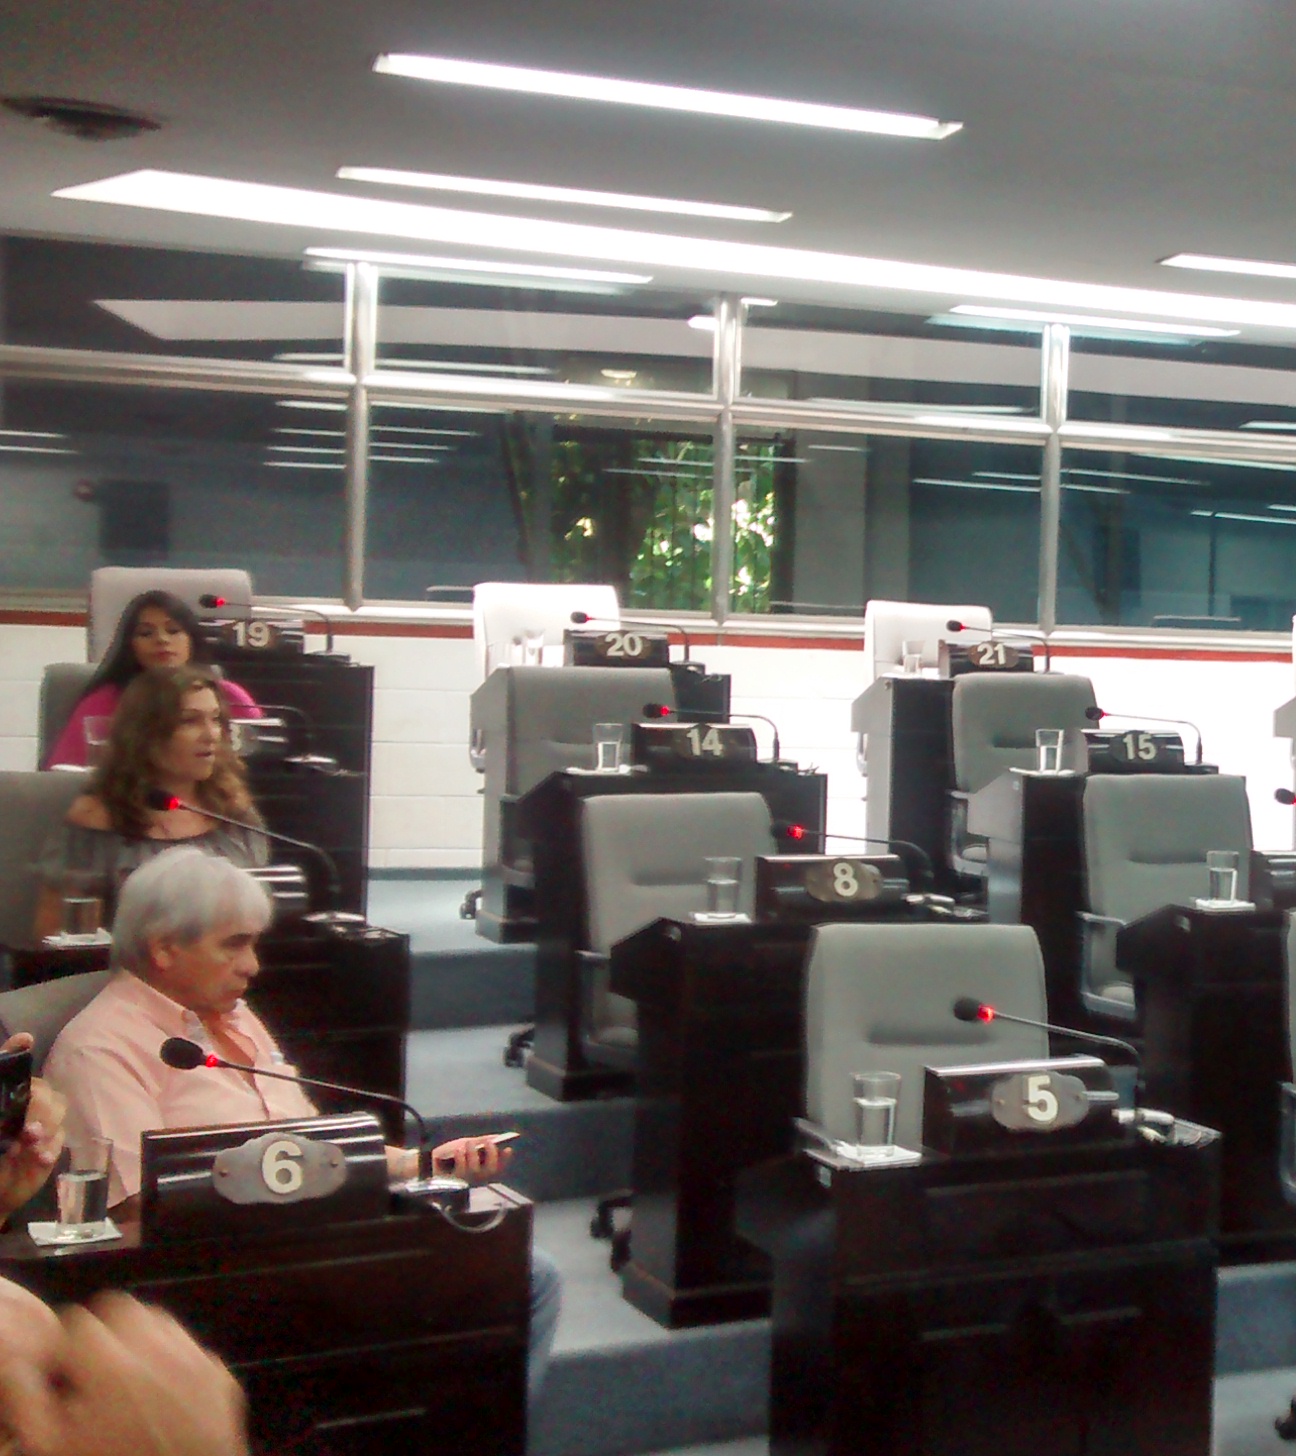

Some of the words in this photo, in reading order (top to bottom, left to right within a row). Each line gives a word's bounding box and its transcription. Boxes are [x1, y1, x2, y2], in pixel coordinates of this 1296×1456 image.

[233, 622, 270, 647] 19
[606, 634, 643, 657] 20
[977, 643, 1005, 665] 21
[686, 728, 723, 756] 14
[1123, 734, 1156, 760] 15
[833, 862, 858, 897] 8
[1028, 1075, 1058, 1122] 5
[262, 1141, 304, 1194] 6
